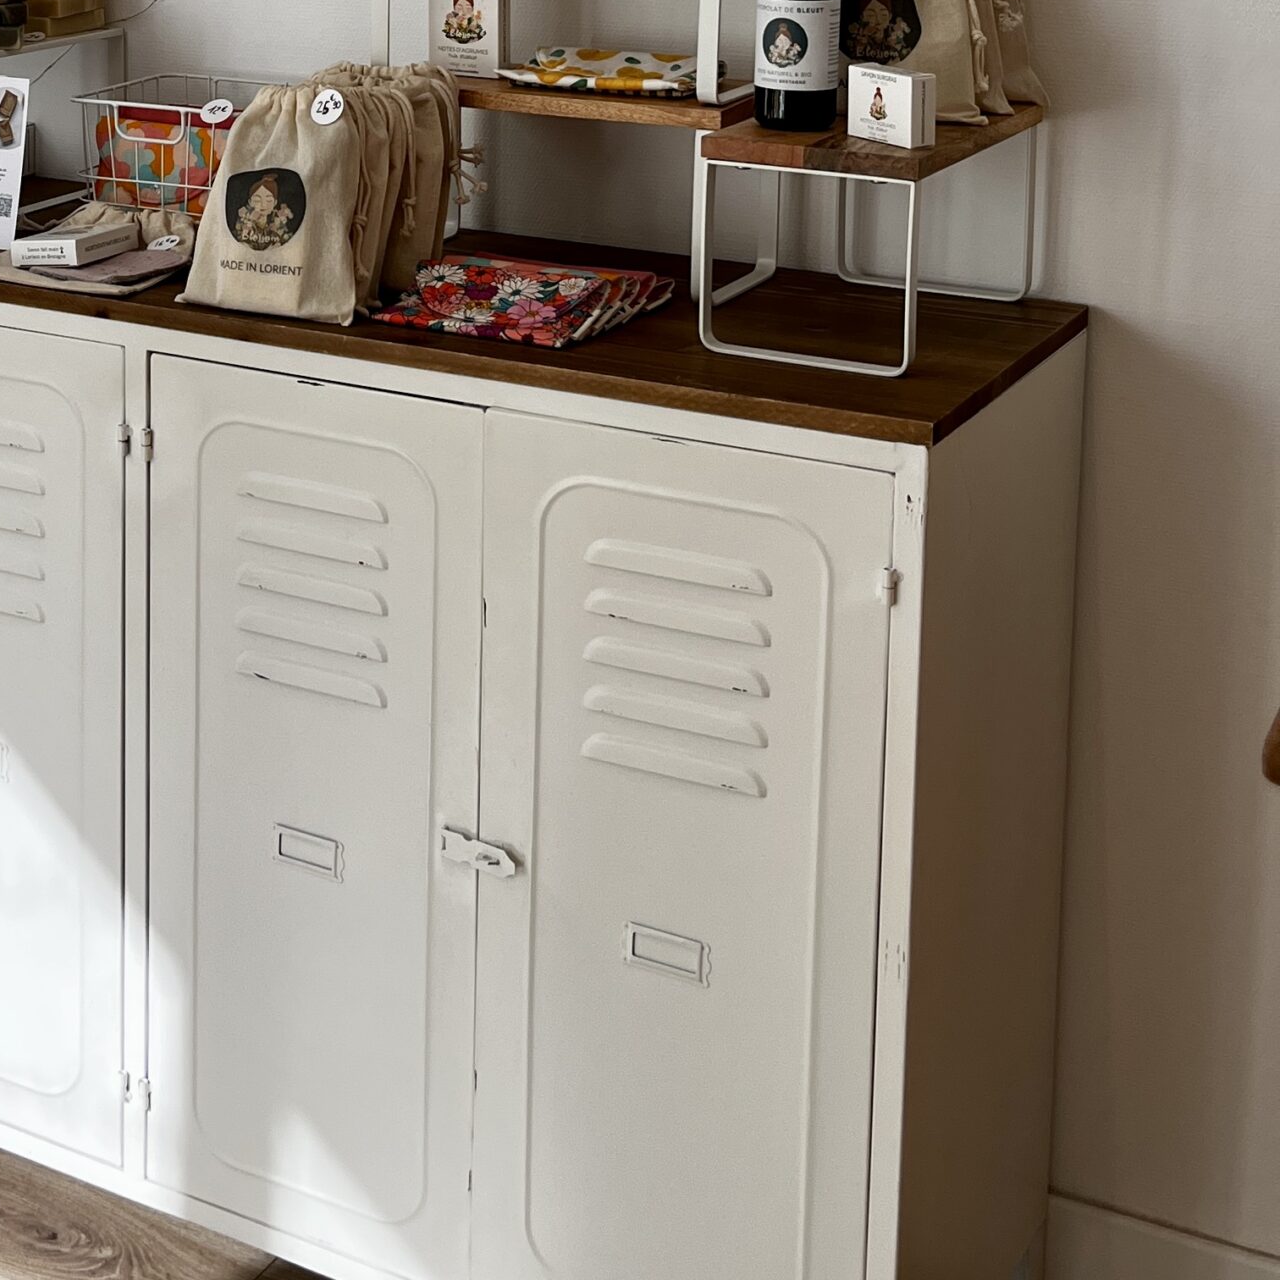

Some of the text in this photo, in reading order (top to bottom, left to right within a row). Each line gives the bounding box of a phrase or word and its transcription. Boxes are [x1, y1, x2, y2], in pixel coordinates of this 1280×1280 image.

[316, 94, 341, 115] 25€90
[220, 260, 243, 270] MADE
[259, 264, 304, 276] LORIENT
